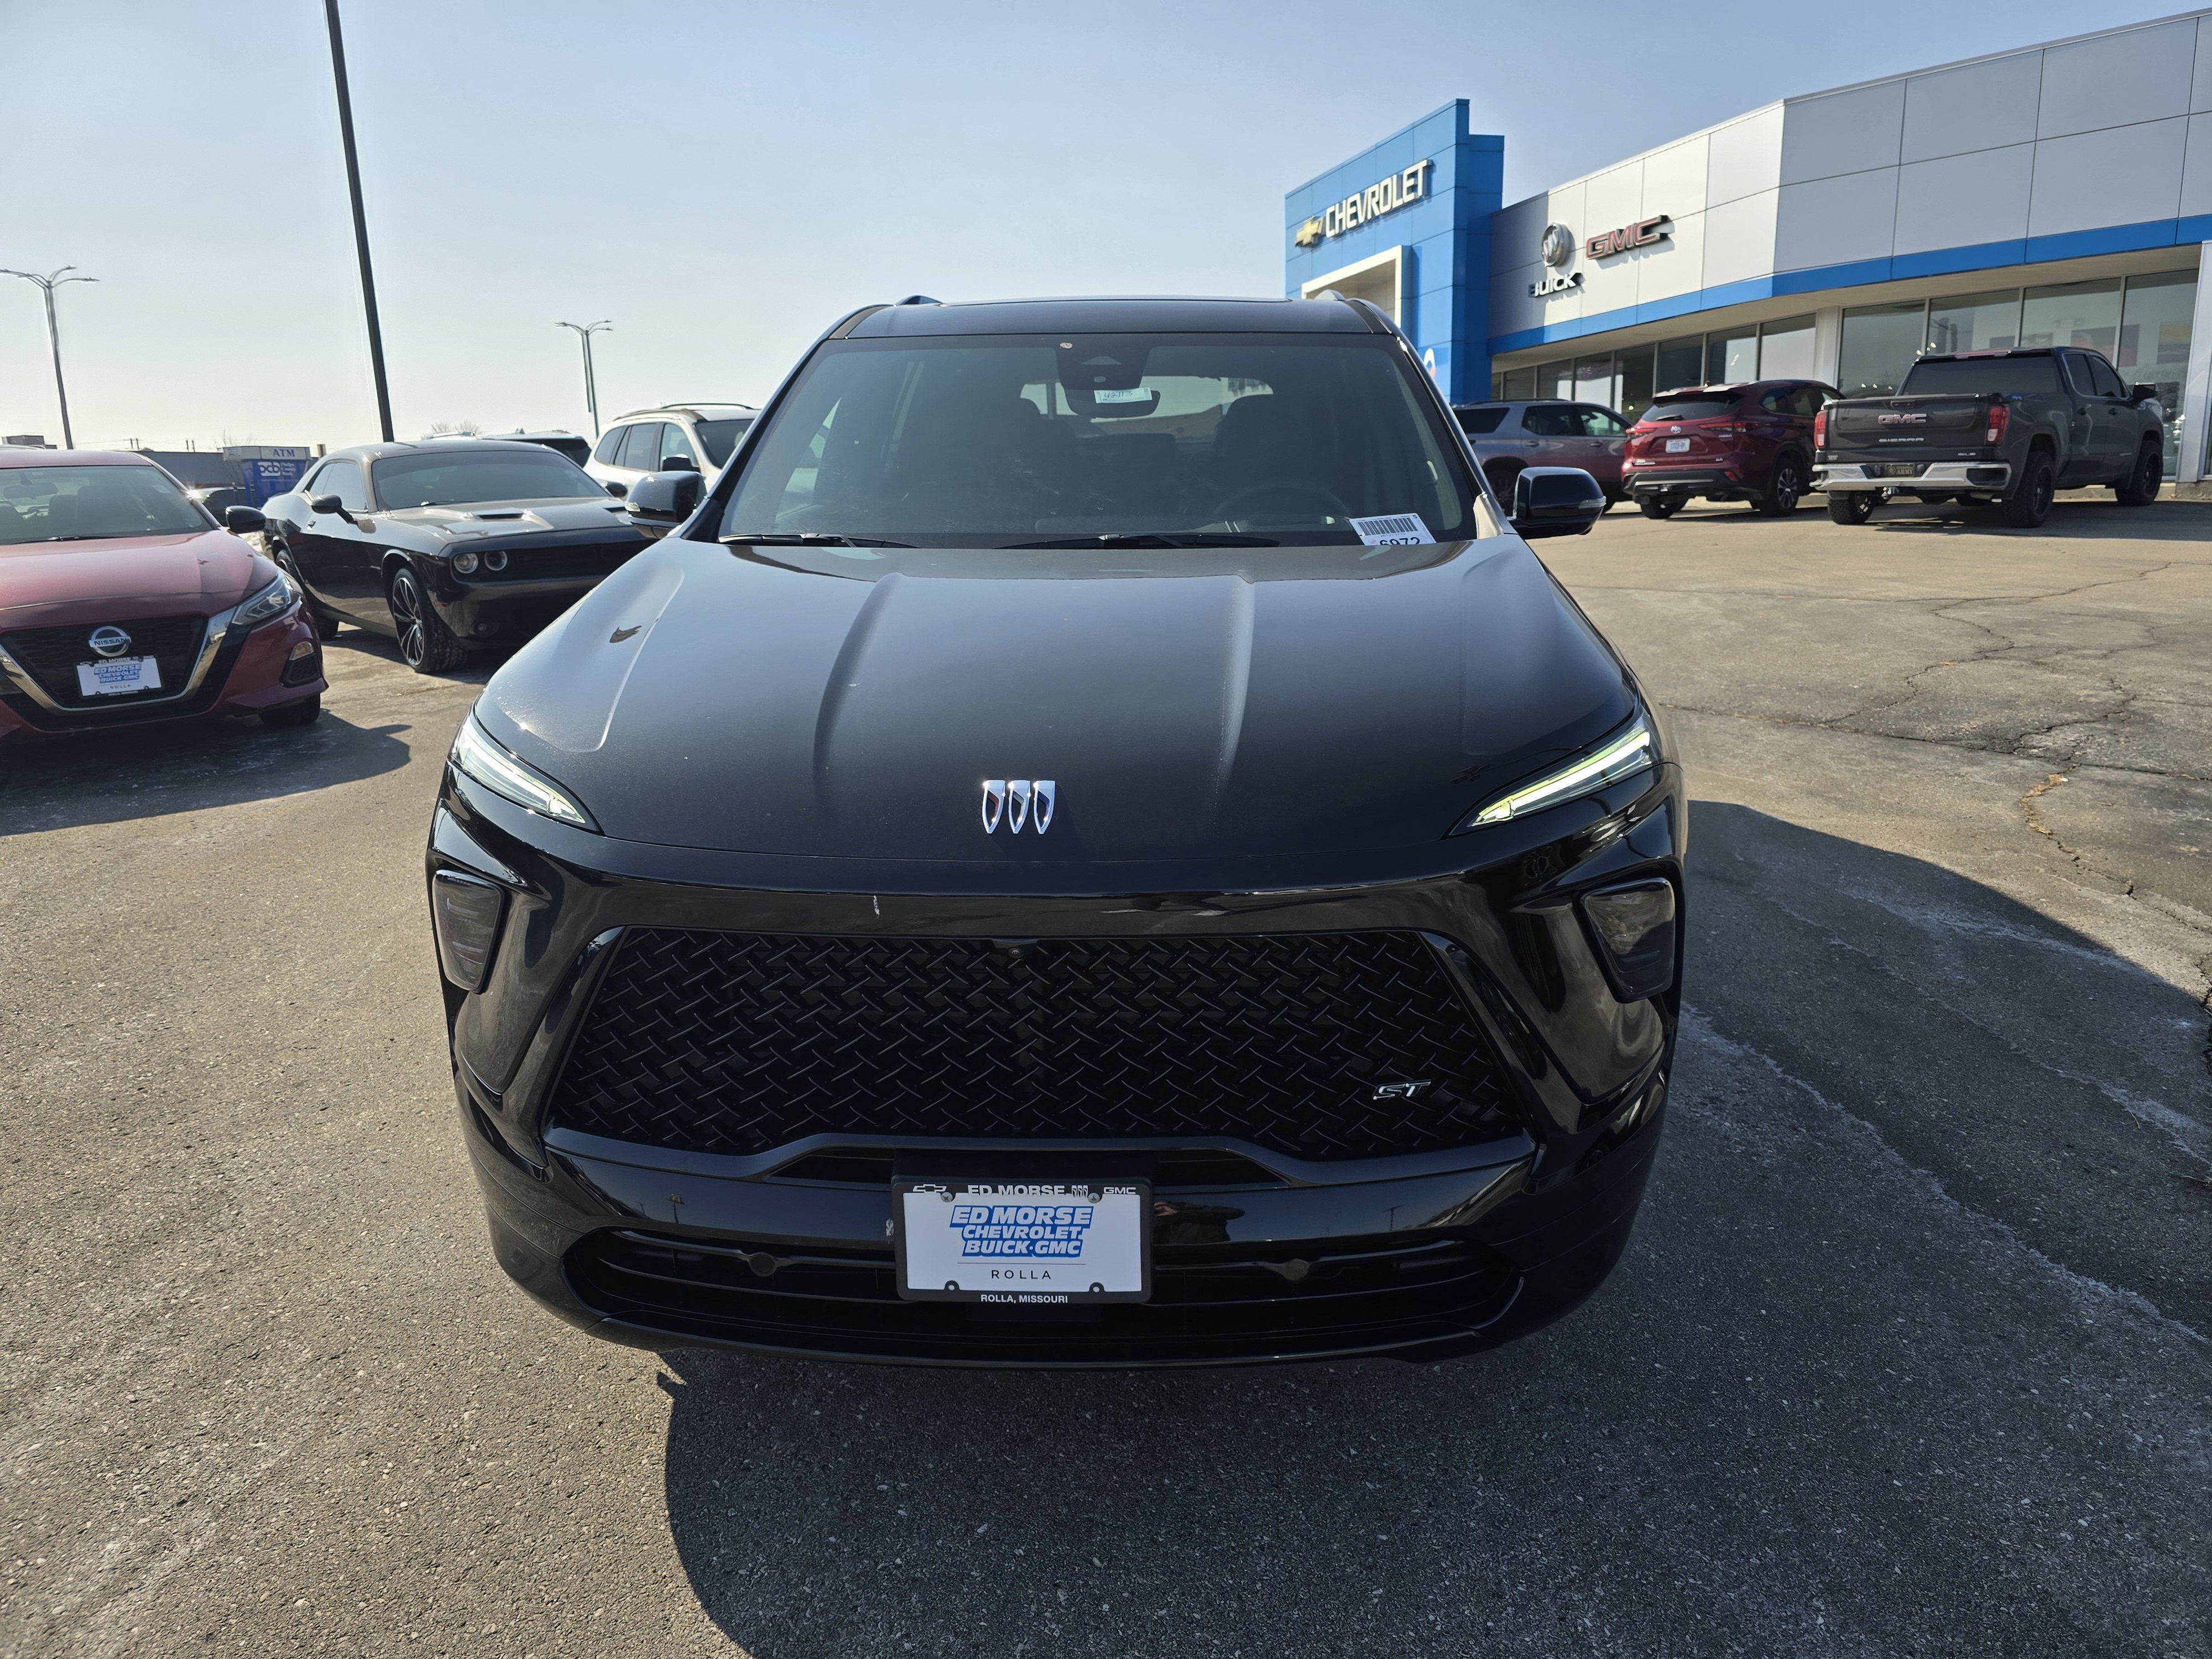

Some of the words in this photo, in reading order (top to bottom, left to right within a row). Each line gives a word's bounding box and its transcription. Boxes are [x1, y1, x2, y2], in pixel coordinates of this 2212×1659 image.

[1326, 159, 1428, 238] CHEVROLET
[1585, 215, 1662, 260] GMC
[1878, 413, 1927, 425] GMC
[273, 448, 295, 457] ATM
[94, 638, 128, 646] NISSAN
[107, 664, 141, 672] MORSE
[1372, 1079, 1432, 1100] ST
[968, 1185, 993, 1196] ED
[998, 1185, 1066, 1196] MORSE
[952, 1207, 989, 1224] ED
[991, 1207, 1092, 1225] MORSE
[963, 1225, 1082, 1239] CHEVROLET
[991, 1270, 1052, 1280] ROLLA
[980, 1294, 1016, 1304] ROLLA,
[1019, 1295, 1069, 1303] MISSOURI
